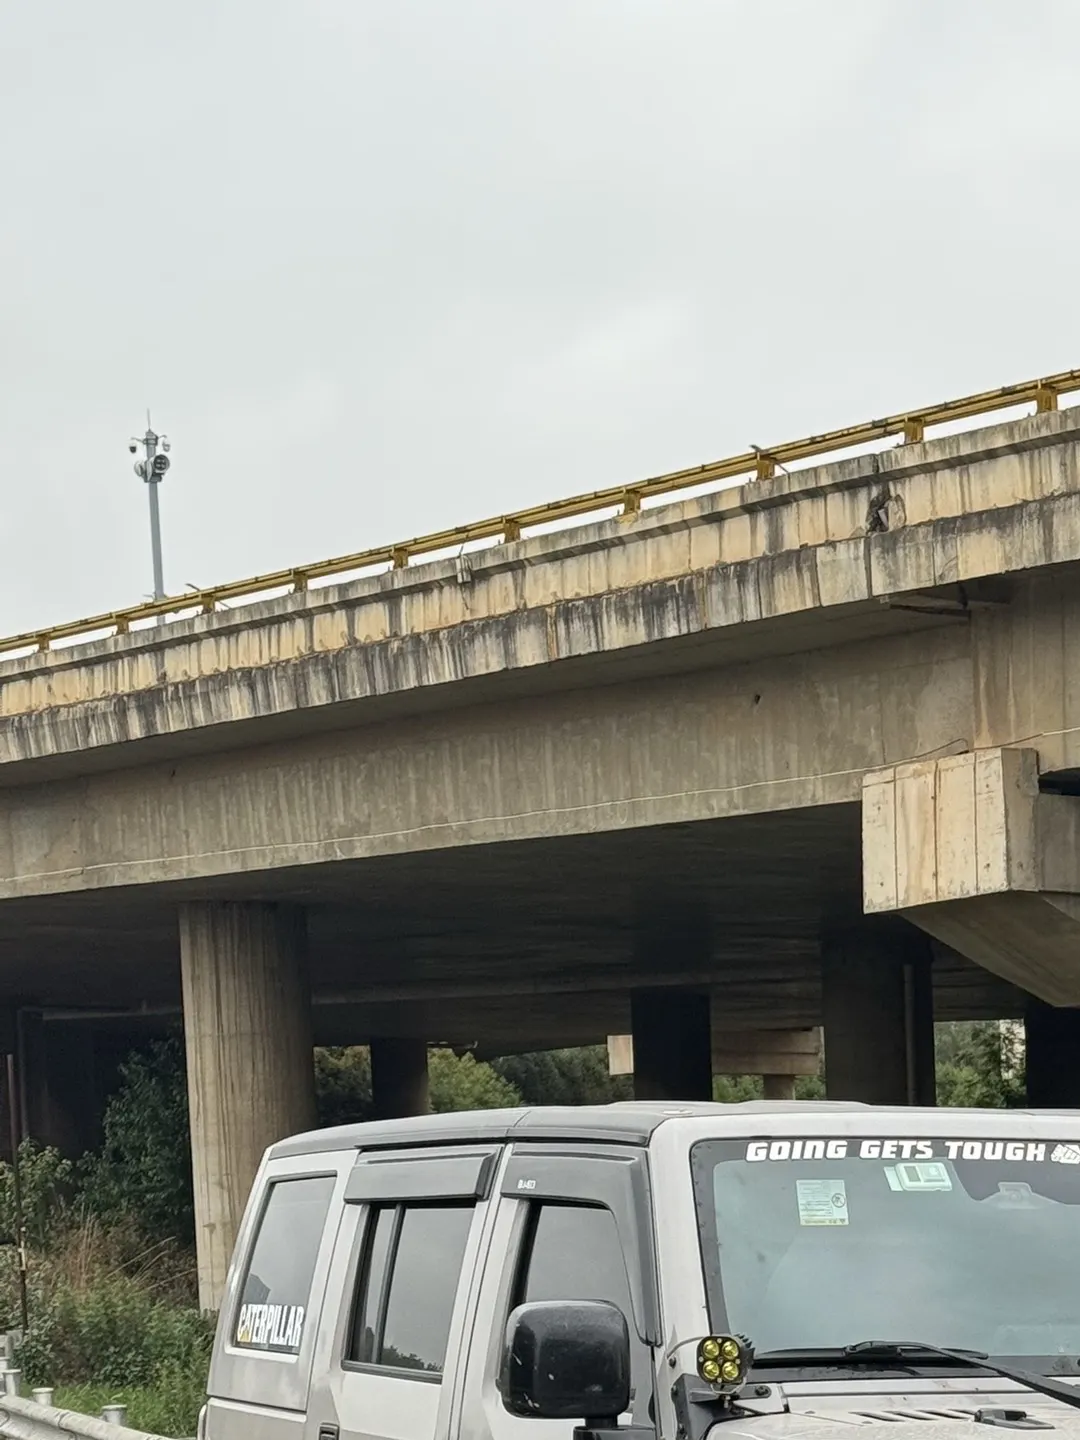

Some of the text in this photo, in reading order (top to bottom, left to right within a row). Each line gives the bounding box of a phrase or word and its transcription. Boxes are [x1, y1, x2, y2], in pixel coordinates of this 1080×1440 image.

[745, 1140, 848, 1162] GOING
[859, 1140, 933, 1159] GETS
[945, 1141, 1045, 1161] TOUGH
[237, 1304, 305, 1347] CATERPILLAR
